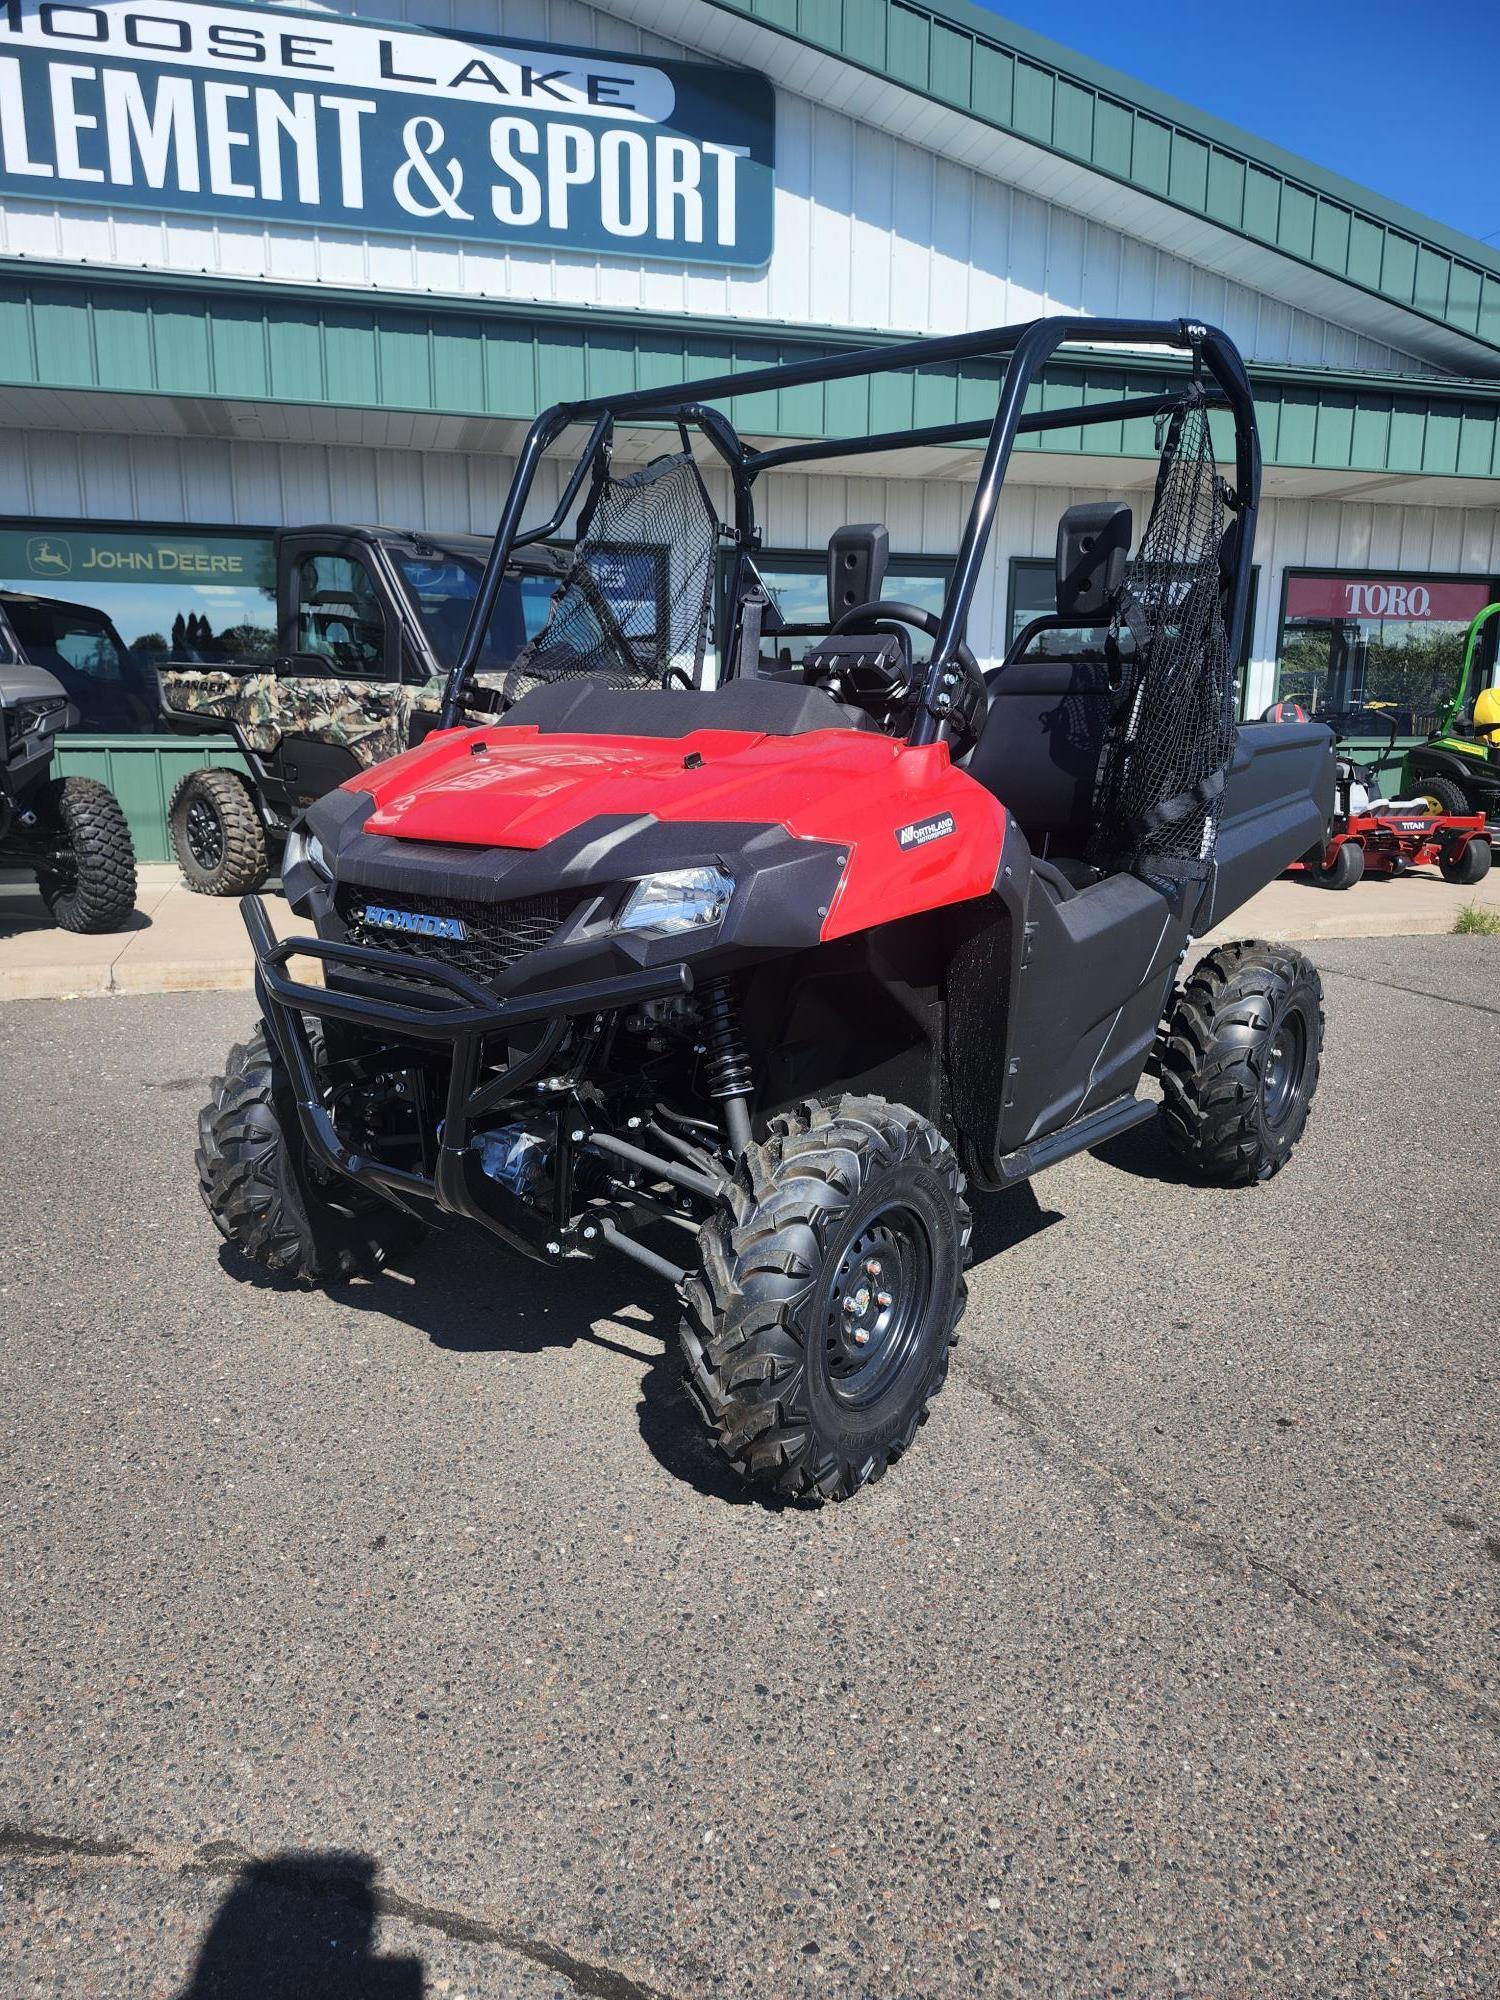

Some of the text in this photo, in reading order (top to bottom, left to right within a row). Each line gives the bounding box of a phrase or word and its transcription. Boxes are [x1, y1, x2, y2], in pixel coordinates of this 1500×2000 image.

[380, 40, 637, 110] LAKE
[0, 56, 750, 247] LEMENT & SPORT
[82, 548, 243, 573] JOHN DEERE
[174, 679, 228, 693] RANGER
[901, 818, 953, 844] NORTHLAND
[917, 827, 953, 844] MOTORSPORTS
[1402, 821, 1425, 830] TITAN
[364, 905, 468, 941] HONDA
